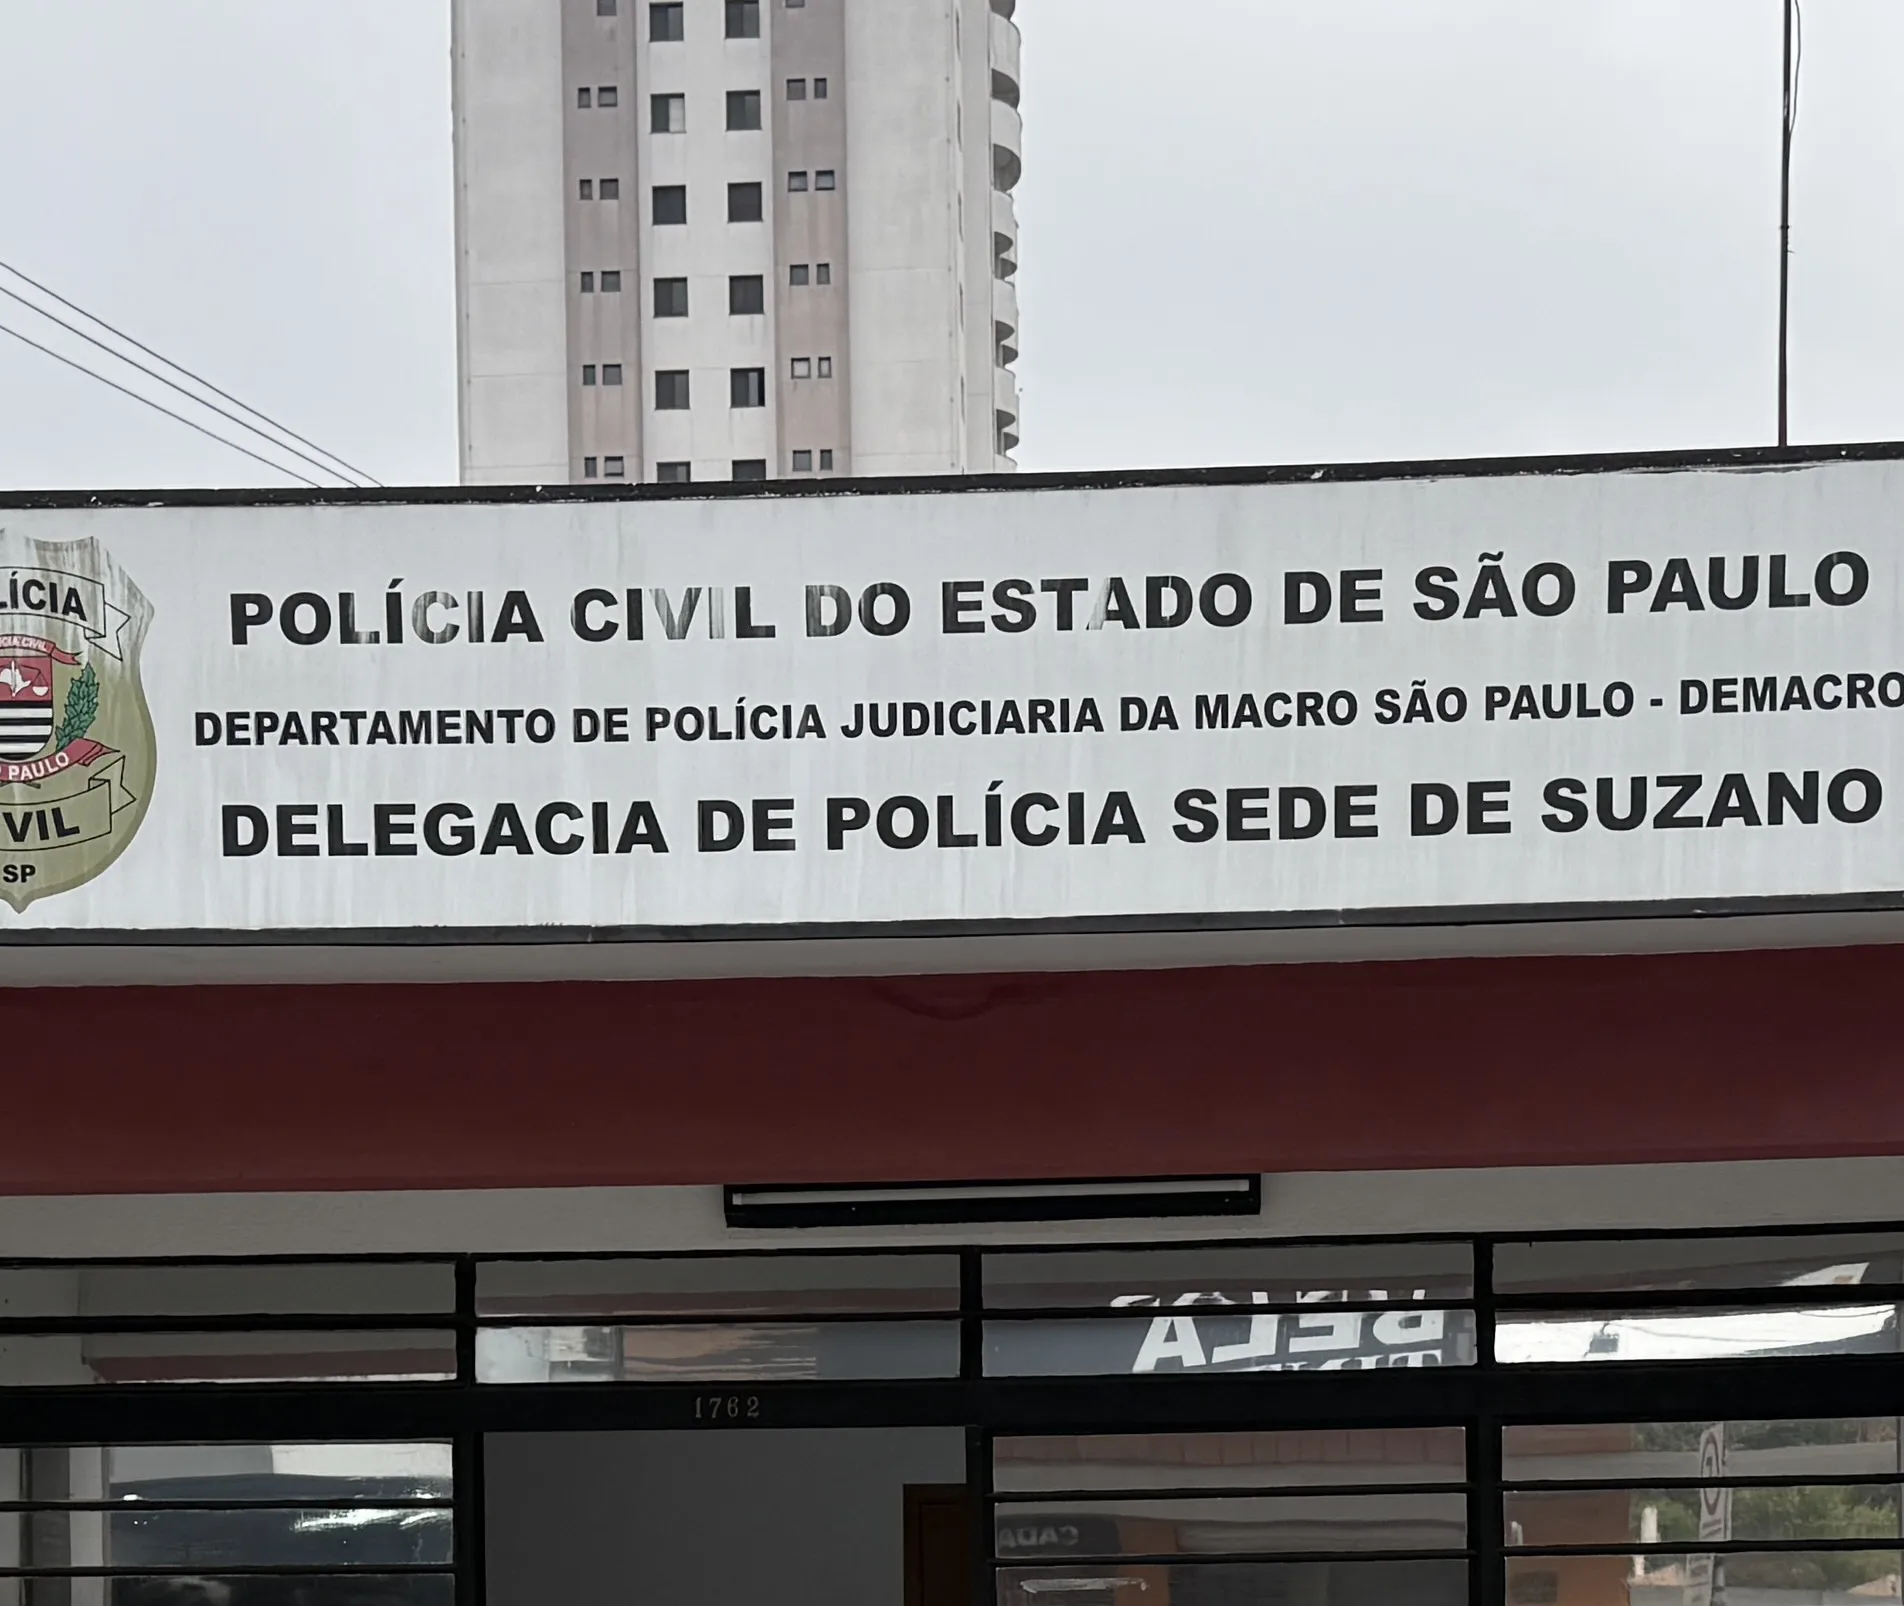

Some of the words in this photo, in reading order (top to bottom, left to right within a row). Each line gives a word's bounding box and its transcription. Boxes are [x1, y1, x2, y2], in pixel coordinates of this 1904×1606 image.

[231, 579, 544, 645] POLÍCIA
[571, 588, 775, 642] CIVIL
[806, 583, 910, 637] DO
[942, 573, 1252, 633] ESTADO
[1284, 569, 1383, 624] DE
[1413, 551, 1575, 620] SÃO
[1608, 551, 1869, 613] PAULO
[195, 709, 555, 746] DEPARTAMENTO
[573, 708, 629, 743] DE
[646, 697, 826, 742] POLÍCIA
[841, 698, 1104, 738] JUDICIARIA
[1121, 696, 1179, 731] DA
[1196, 691, 1357, 729] MACRO
[1375, 680, 1467, 724] SÃO
[1486, 682, 1633, 720] PAULO
[8, 752, 69, 781] PAULO
[222, 801, 669, 856] DELEGACIA
[698, 799, 795, 852] DE
[827, 780, 1145, 850] POLÍCIA
[1173, 785, 1378, 842] SEDE
[1411, 781, 1511, 836] DE
[1542, 769, 1882, 832] SUZANO
[3, 865, 36, 883] SP
[695, 1396, 759, 1418] 1762
